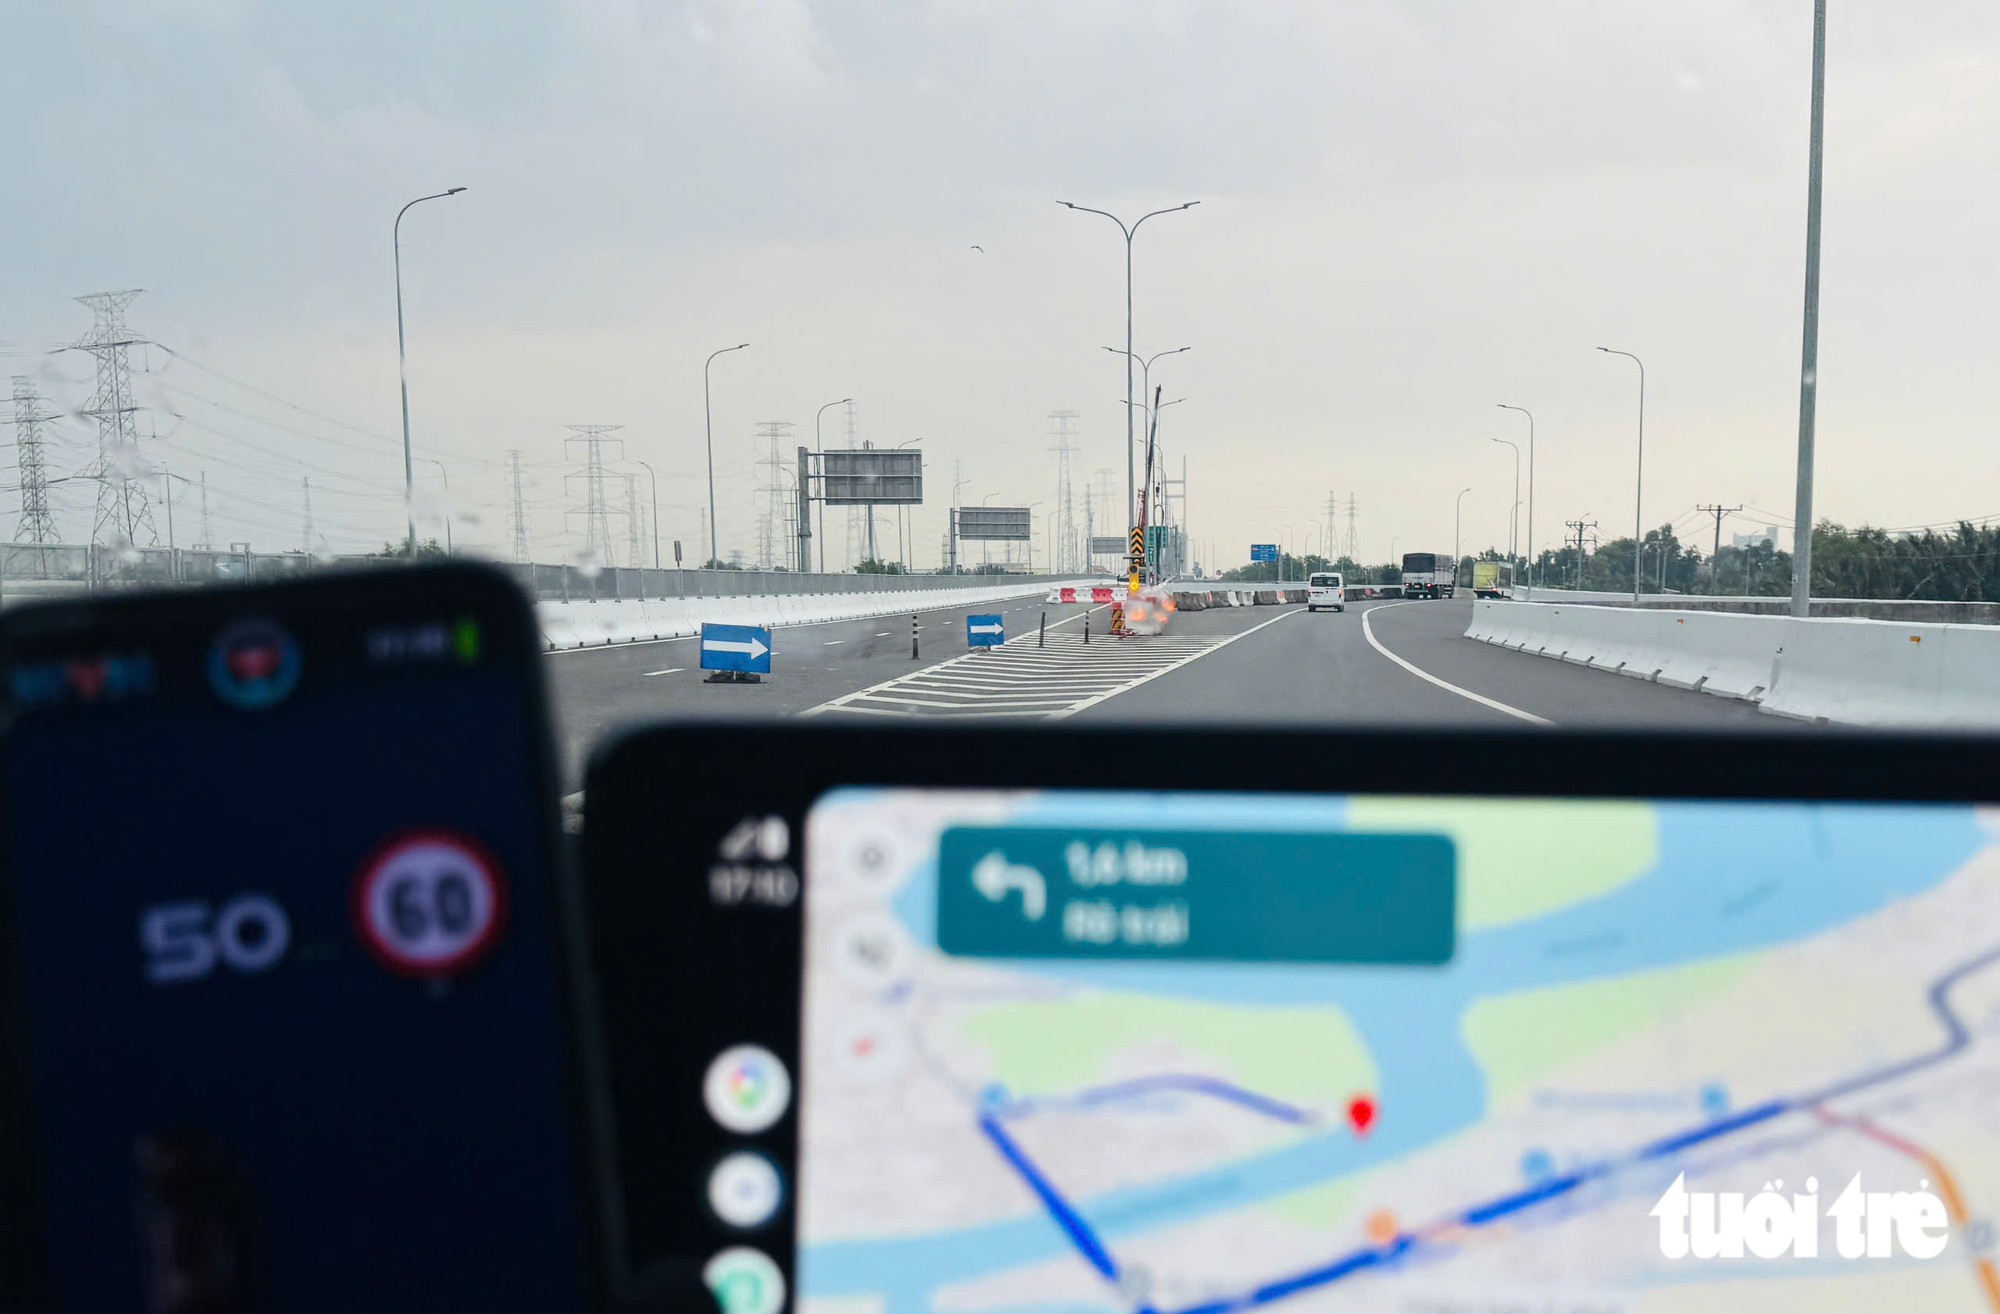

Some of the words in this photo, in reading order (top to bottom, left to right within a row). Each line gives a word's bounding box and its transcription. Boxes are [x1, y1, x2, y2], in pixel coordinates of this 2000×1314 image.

[1125, 840, 1188, 886] km
[139, 893, 291, 984] 50
[388, 872, 472, 941] 60
